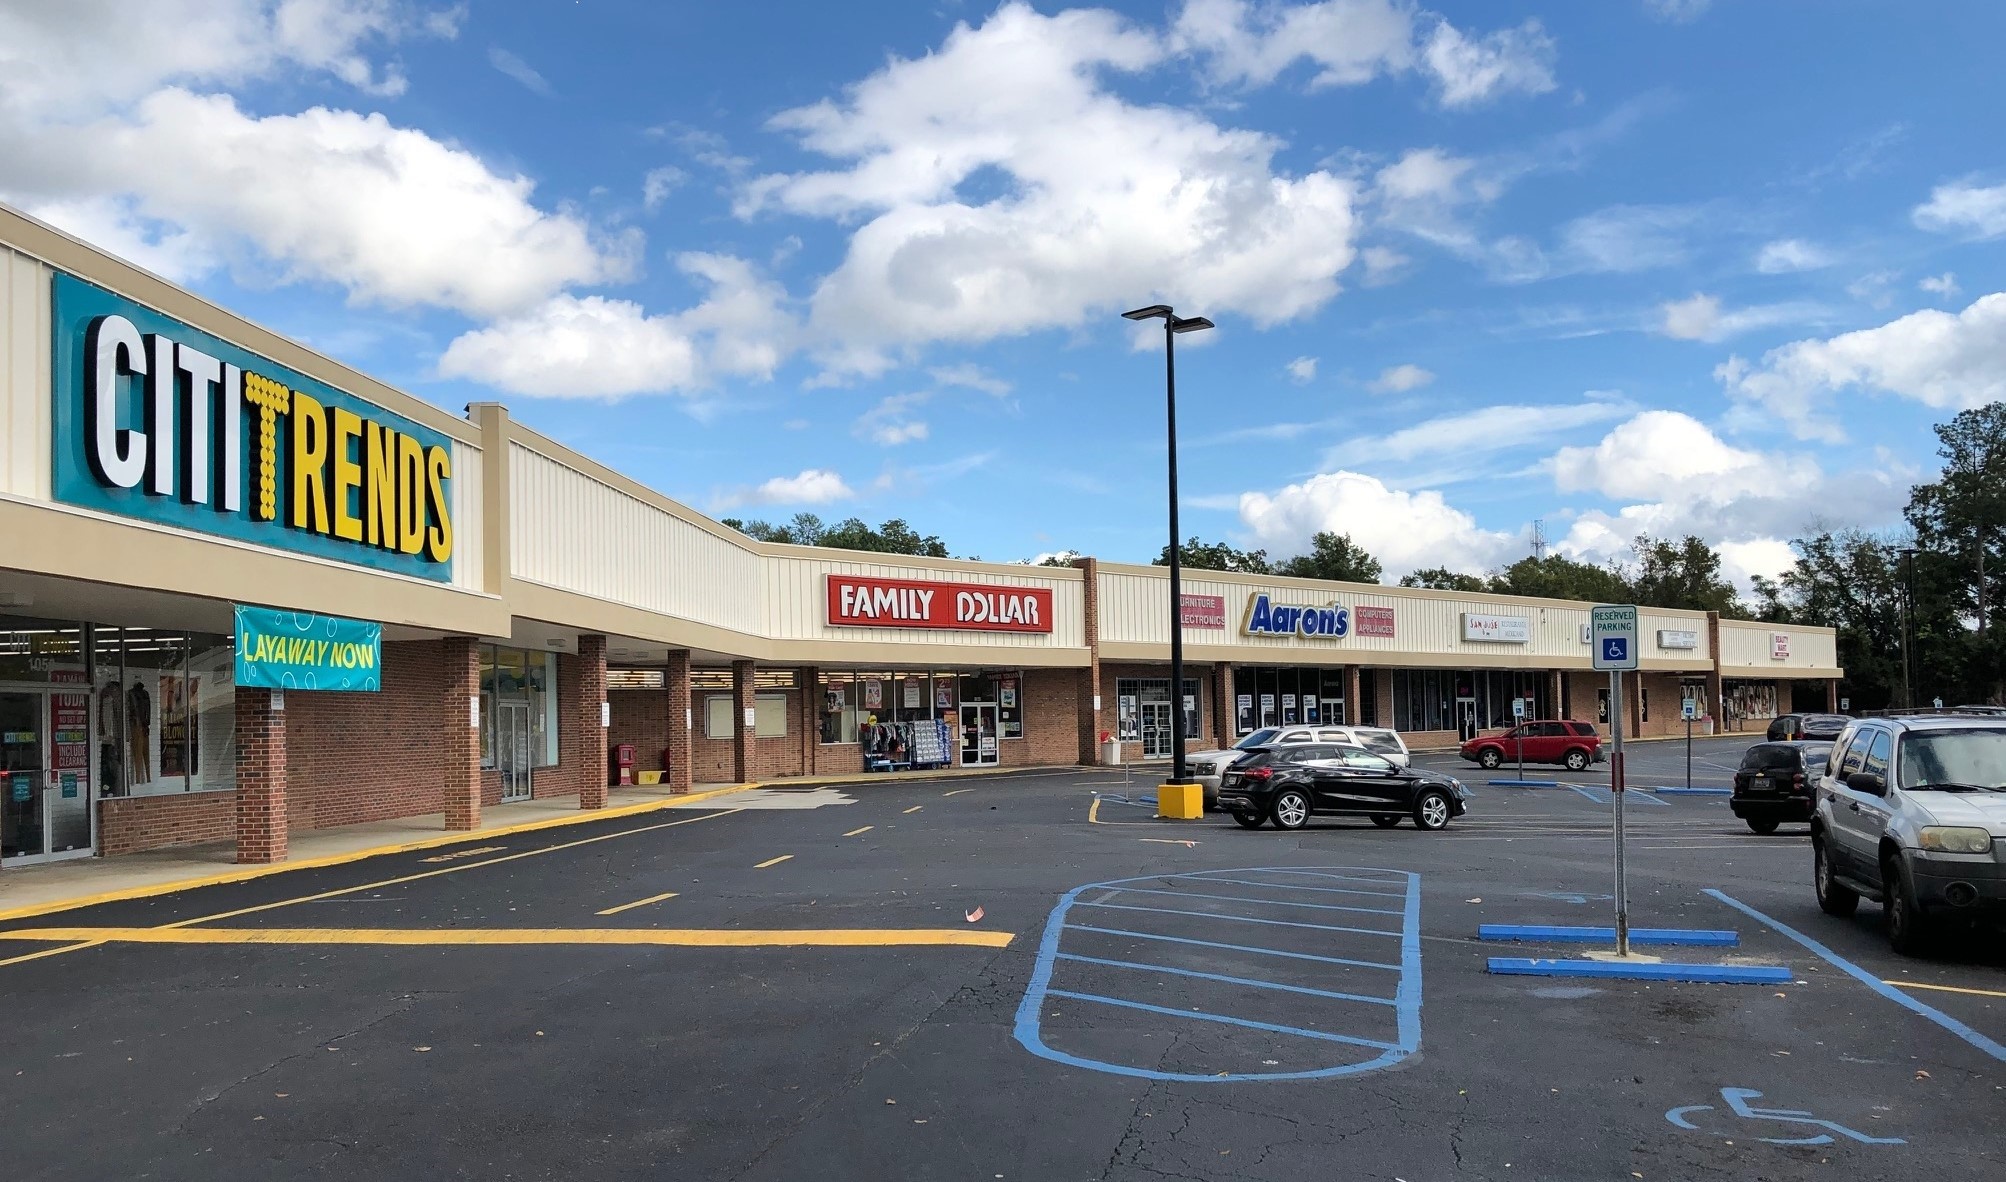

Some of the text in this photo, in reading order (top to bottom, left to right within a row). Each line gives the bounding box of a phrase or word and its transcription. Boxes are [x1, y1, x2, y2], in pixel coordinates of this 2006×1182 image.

[840, 585, 1040, 625] FAMILY DOLLAR
[1181, 597, 1216, 608] URNITURE
[1247, 593, 1350, 636] Aaron's
[1357, 608, 1393, 619] COMPUTERS
[1595, 611, 1634, 620] RESERVED
[1181, 614, 1225, 626] LECTRONICS
[1358, 624, 1394, 634] APPLIANCES
[1597, 622, 1632, 631] PARKING
[243, 632, 374, 669] LAYAWAY NOW
[59, 757, 87, 767] CLEARANC
